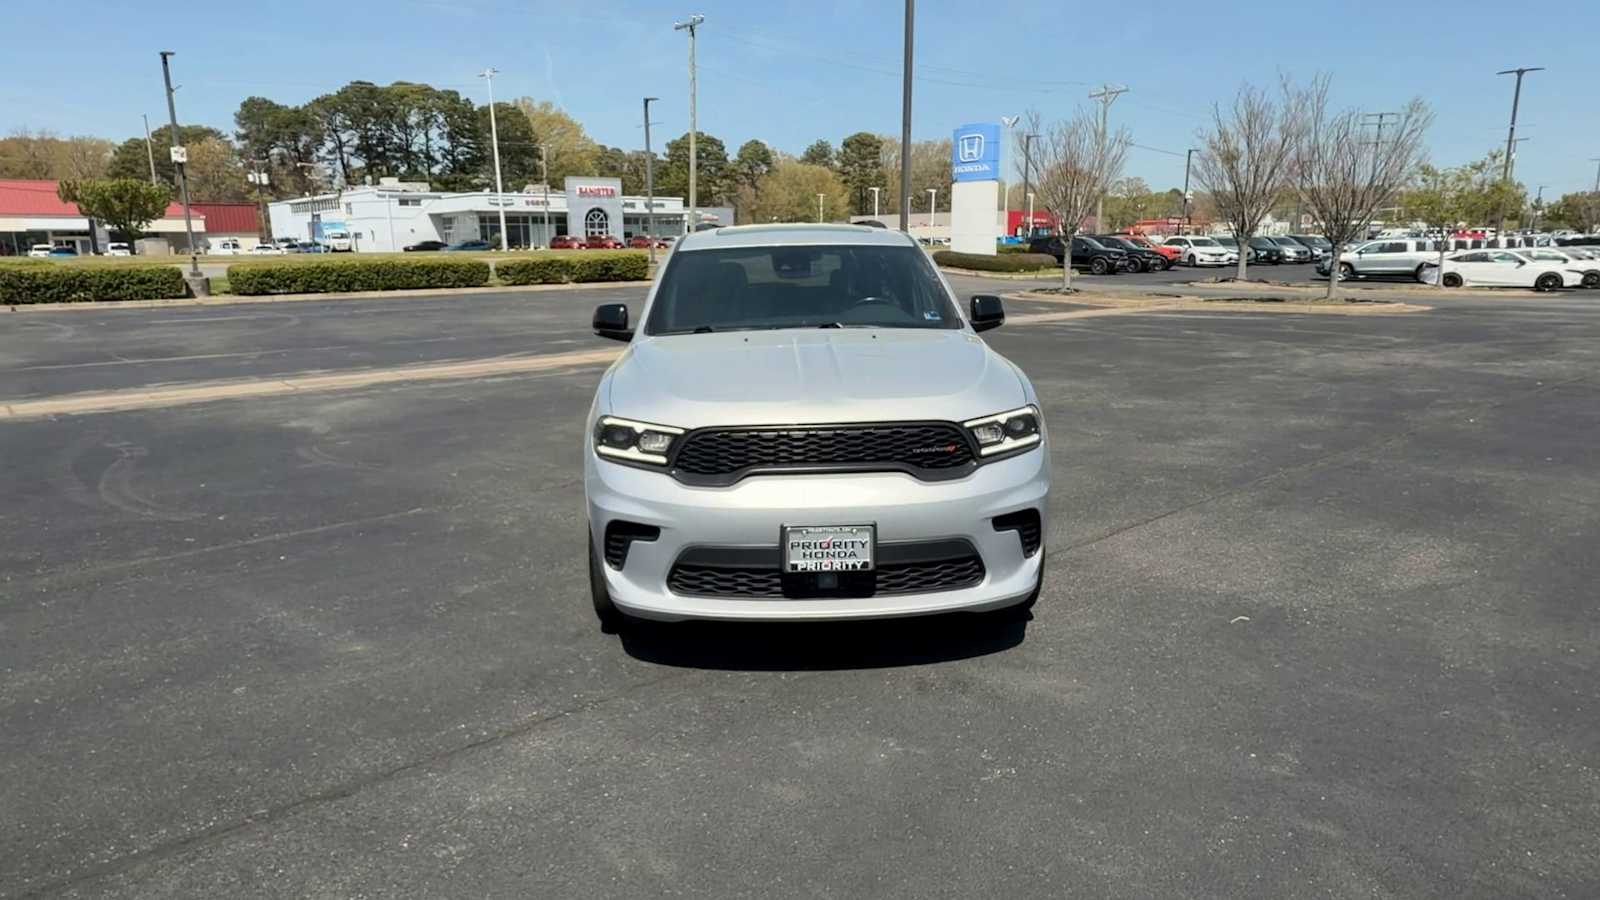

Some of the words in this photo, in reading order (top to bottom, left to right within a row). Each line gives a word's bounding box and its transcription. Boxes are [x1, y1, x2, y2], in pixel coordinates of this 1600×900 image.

[953, 163, 991, 173] HONDA
[790, 539, 868, 550] PRIORITY
[802, 550, 857, 559] HONDA
[798, 561, 864, 571] PRIORITY
